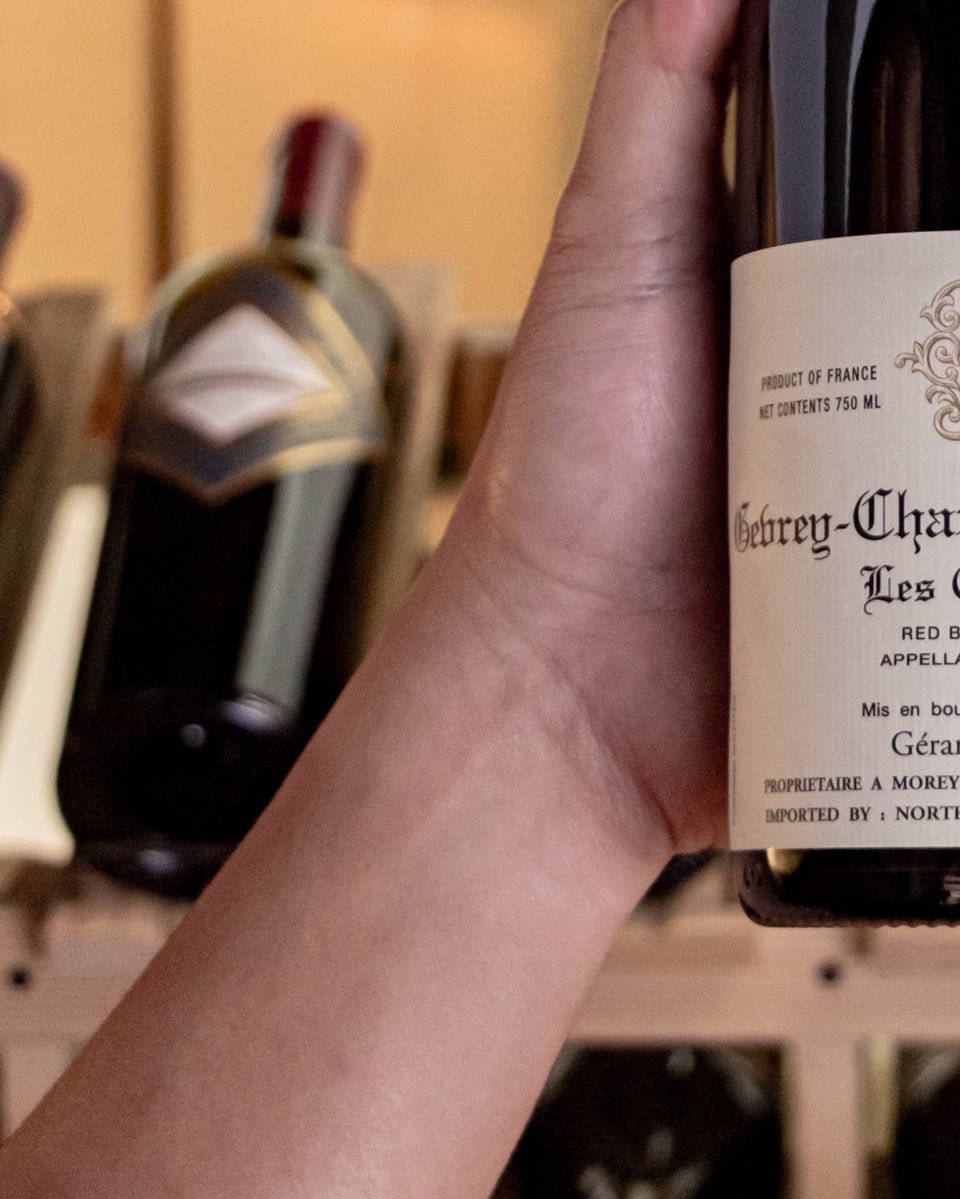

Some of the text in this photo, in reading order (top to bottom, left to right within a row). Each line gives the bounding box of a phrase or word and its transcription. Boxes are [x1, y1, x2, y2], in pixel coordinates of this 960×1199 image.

[761, 365, 877, 392] PRODUCT OF FRANCE
[760, 393, 881, 419] NET CONTENTS 750 ML
[859, 563, 936, 615] Les
[901, 626, 940, 641] RED
[861, 702, 890, 718] Mis
[900, 703, 921, 717] en
[763, 776, 863, 794] PROPRIETAIRE
[871, 776, 882, 790] A
[765, 807, 840, 824] IMPORTED
[849, 806, 871, 821] BY
